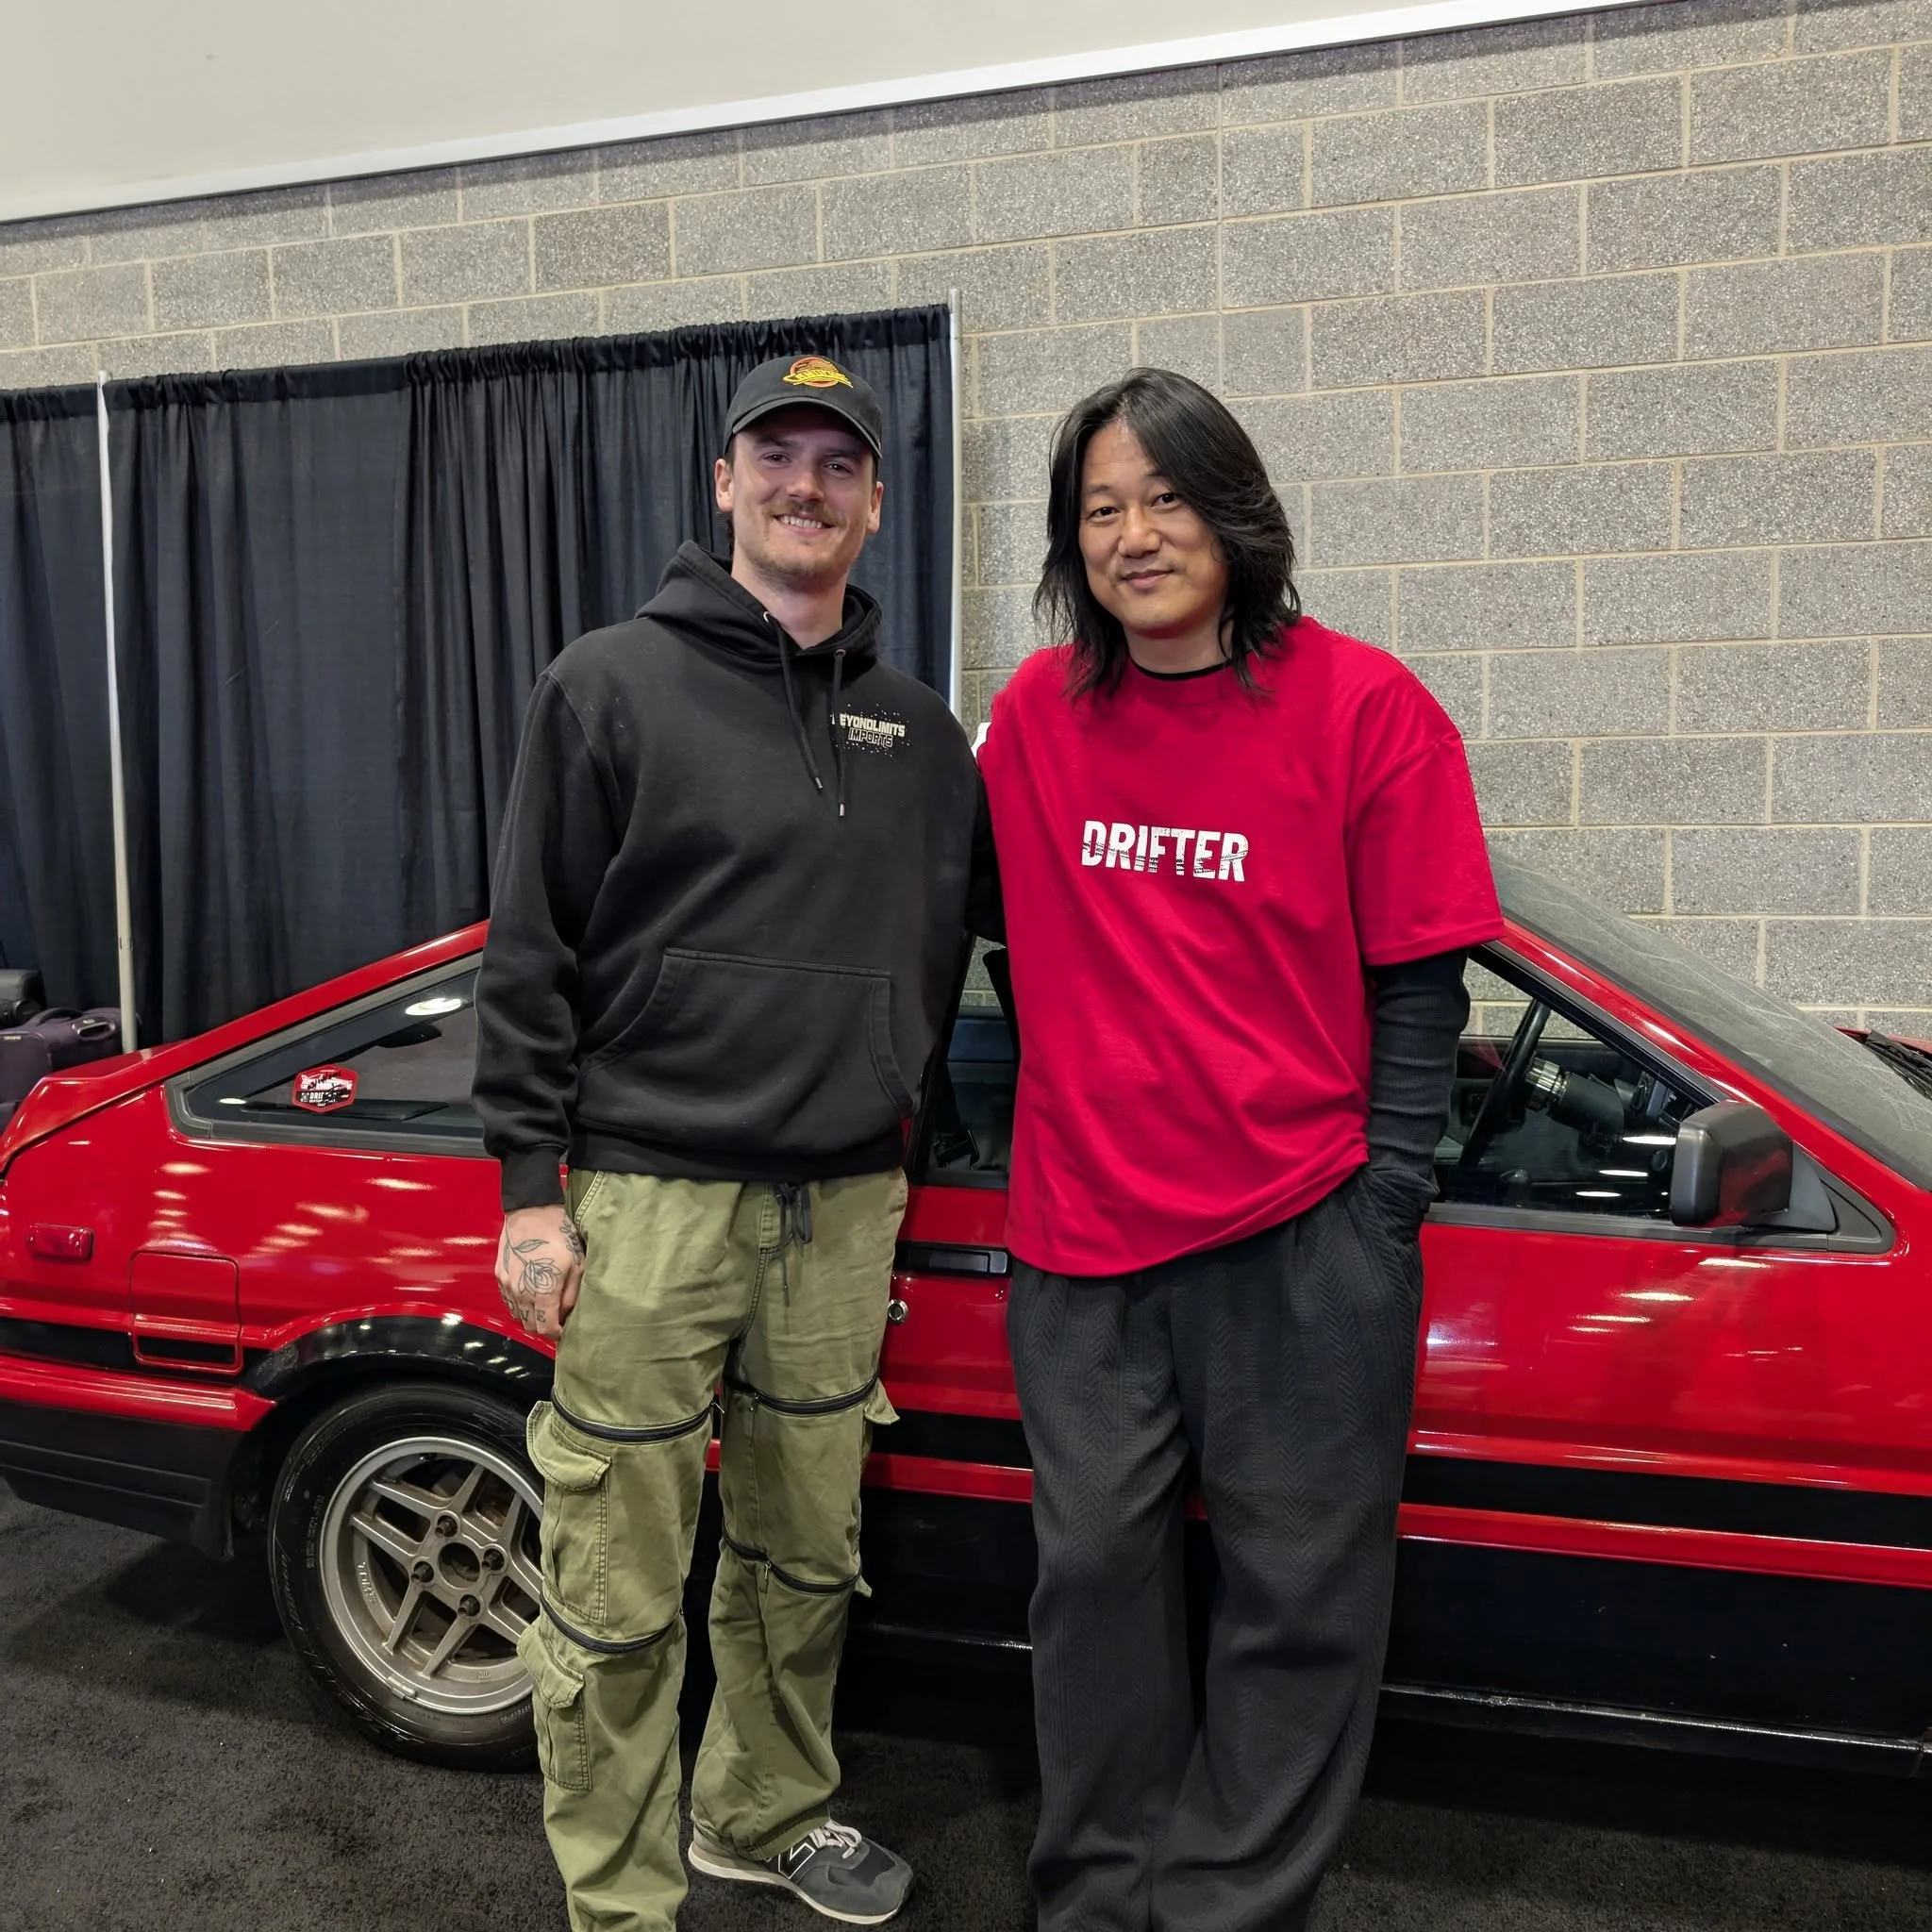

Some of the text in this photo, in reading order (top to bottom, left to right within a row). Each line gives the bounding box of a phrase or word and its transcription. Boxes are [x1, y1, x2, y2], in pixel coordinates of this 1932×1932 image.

[832, 712, 906, 738] EYONDLIMITS
[848, 727, 893, 747] IMPORTS
[1081, 820, 1249, 882] DRIFTER
